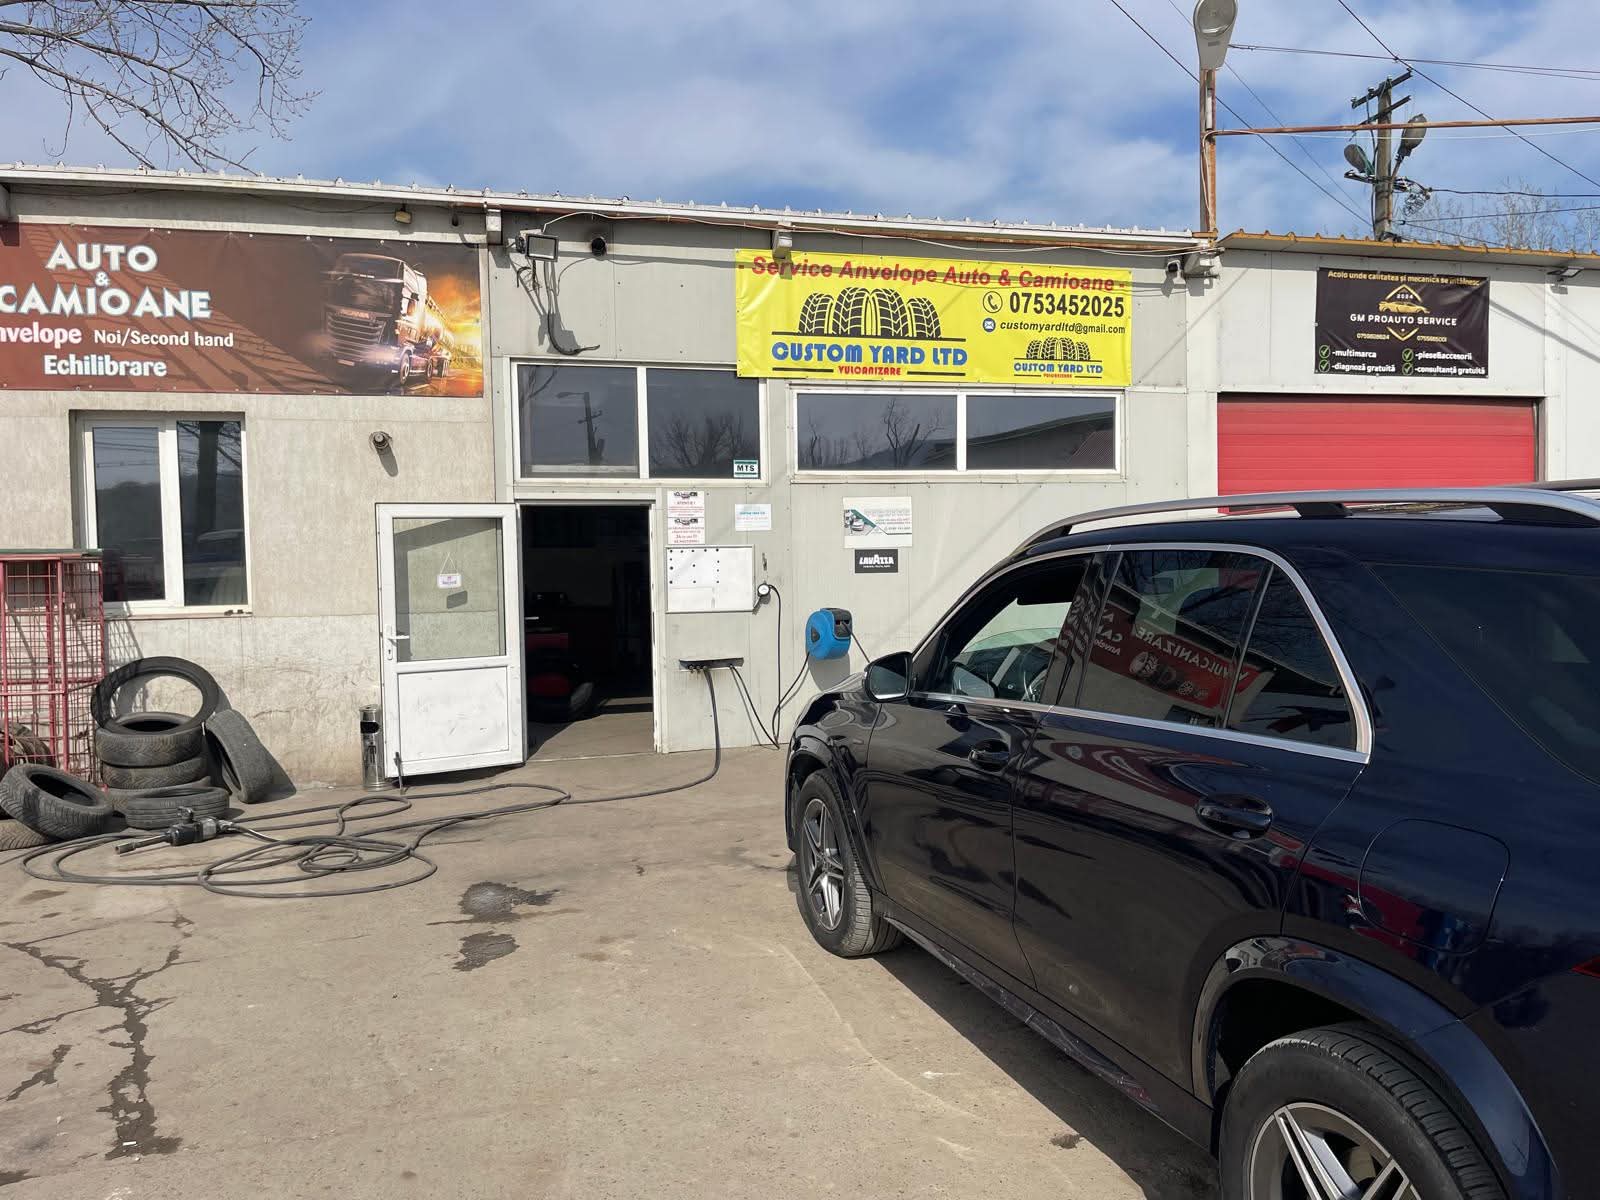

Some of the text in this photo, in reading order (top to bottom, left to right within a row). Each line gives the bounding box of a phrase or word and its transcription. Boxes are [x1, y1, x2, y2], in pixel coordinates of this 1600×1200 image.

[45, 240, 158, 272] AUTO
[95, 271, 111, 287] &
[752, 256, 833, 278] Service
[838, 260, 937, 286] Anvelope
[943, 266, 991, 285] Auto
[998, 269, 1011, 287] &
[1019, 270, 1114, 291] Camioane
[1327, 271, 1348, 279] Acolo
[1348, 272, 1367, 280] unde
[1368, 273, 1399, 281] calitatea
[1407, 275, 1440, 283] mecanica
[0, 282, 211, 320] CAMIOANE
[1009, 291, 1125, 318] 0753452025
[1350, 313, 1458, 326] GM PROAUTO SERVICE
[1000, 321, 1126, 335] customyardltd@gmail.com
[94, 327, 189, 347] Noi/Second
[194, 331, 234, 347] hand
[772, 342, 968, 367] CUSTOM YARD LTD
[44, 353, 167, 377] Echilibrare
[838, 365, 902, 376] VULCANIZARE
[1014, 362, 1103, 374] CUSTOM YARD LTD
[1367, 364, 1396, 373] gratuită
[1458, 366, 1486, 376] gratuită
[736, 464, 755, 472] MTS
[859, 554, 895, 565] LAVAZZA
